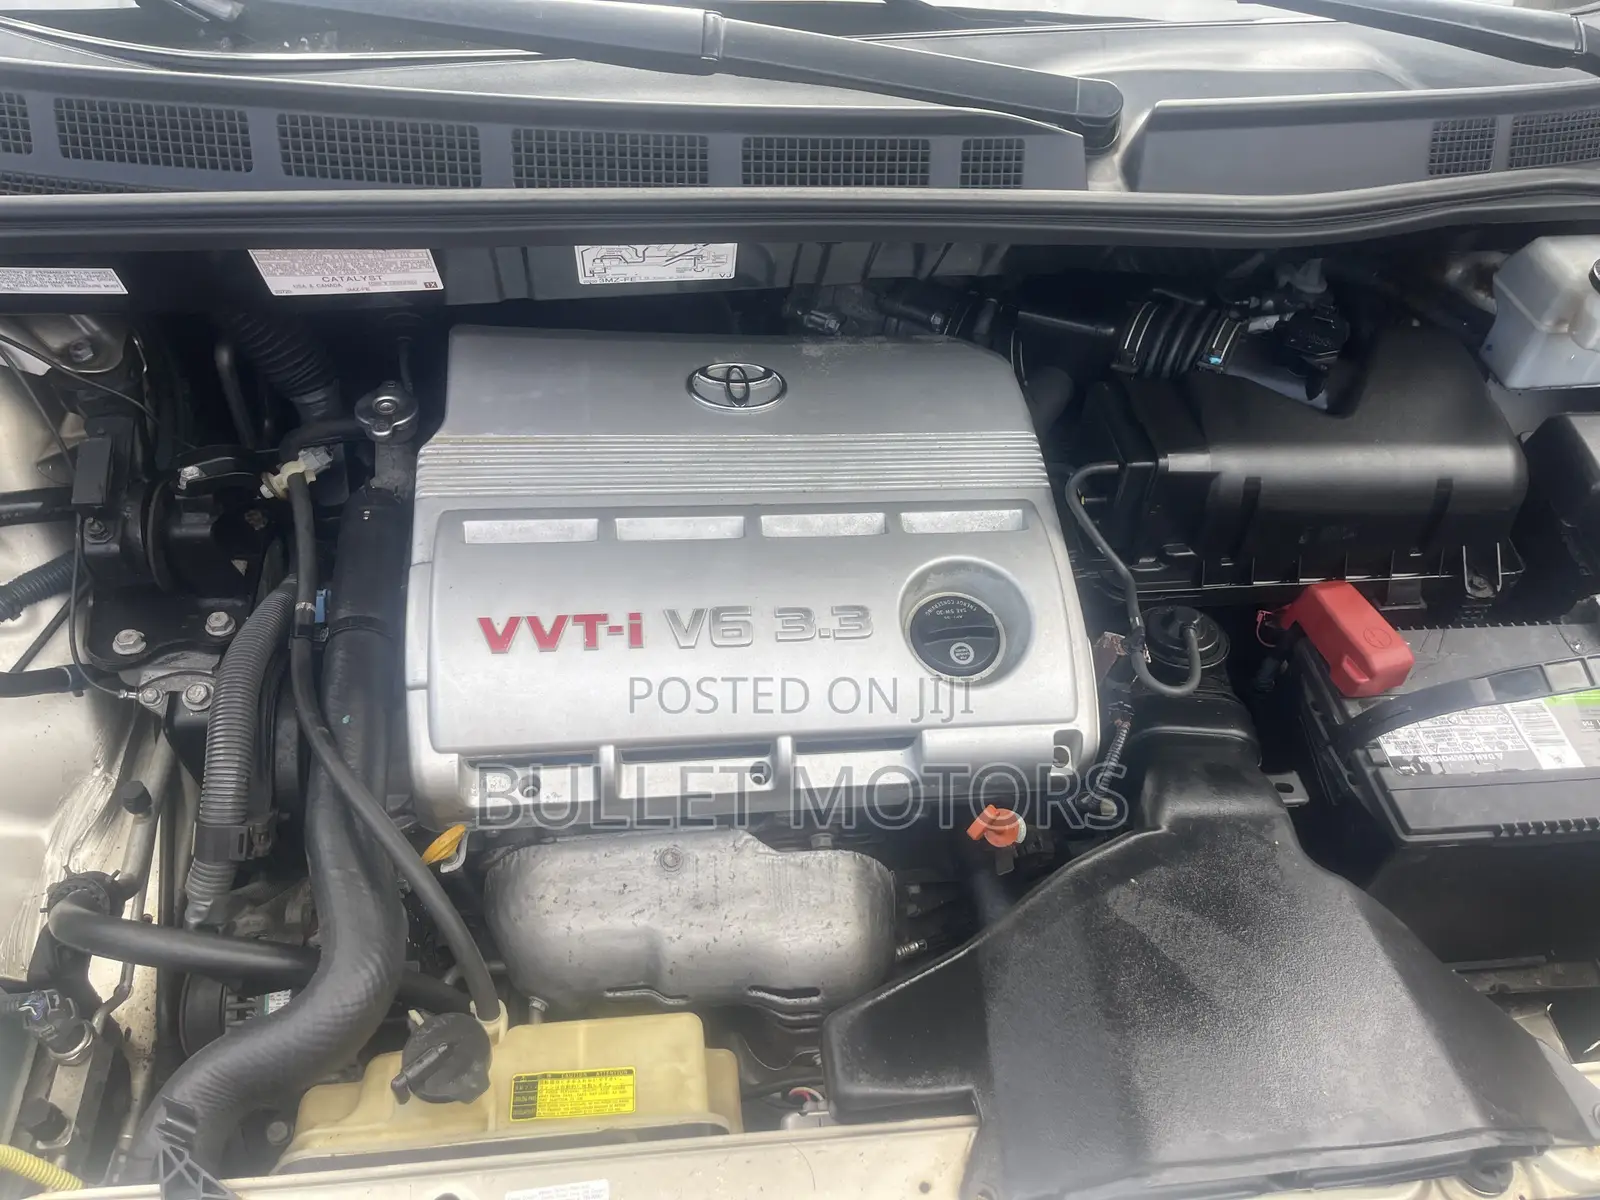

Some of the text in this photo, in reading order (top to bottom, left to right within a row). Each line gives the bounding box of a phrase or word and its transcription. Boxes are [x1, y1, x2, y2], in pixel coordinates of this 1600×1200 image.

[322, 275, 383, 283] CATALYST
[477, 605, 874, 654] VVT-i V6 3.3
